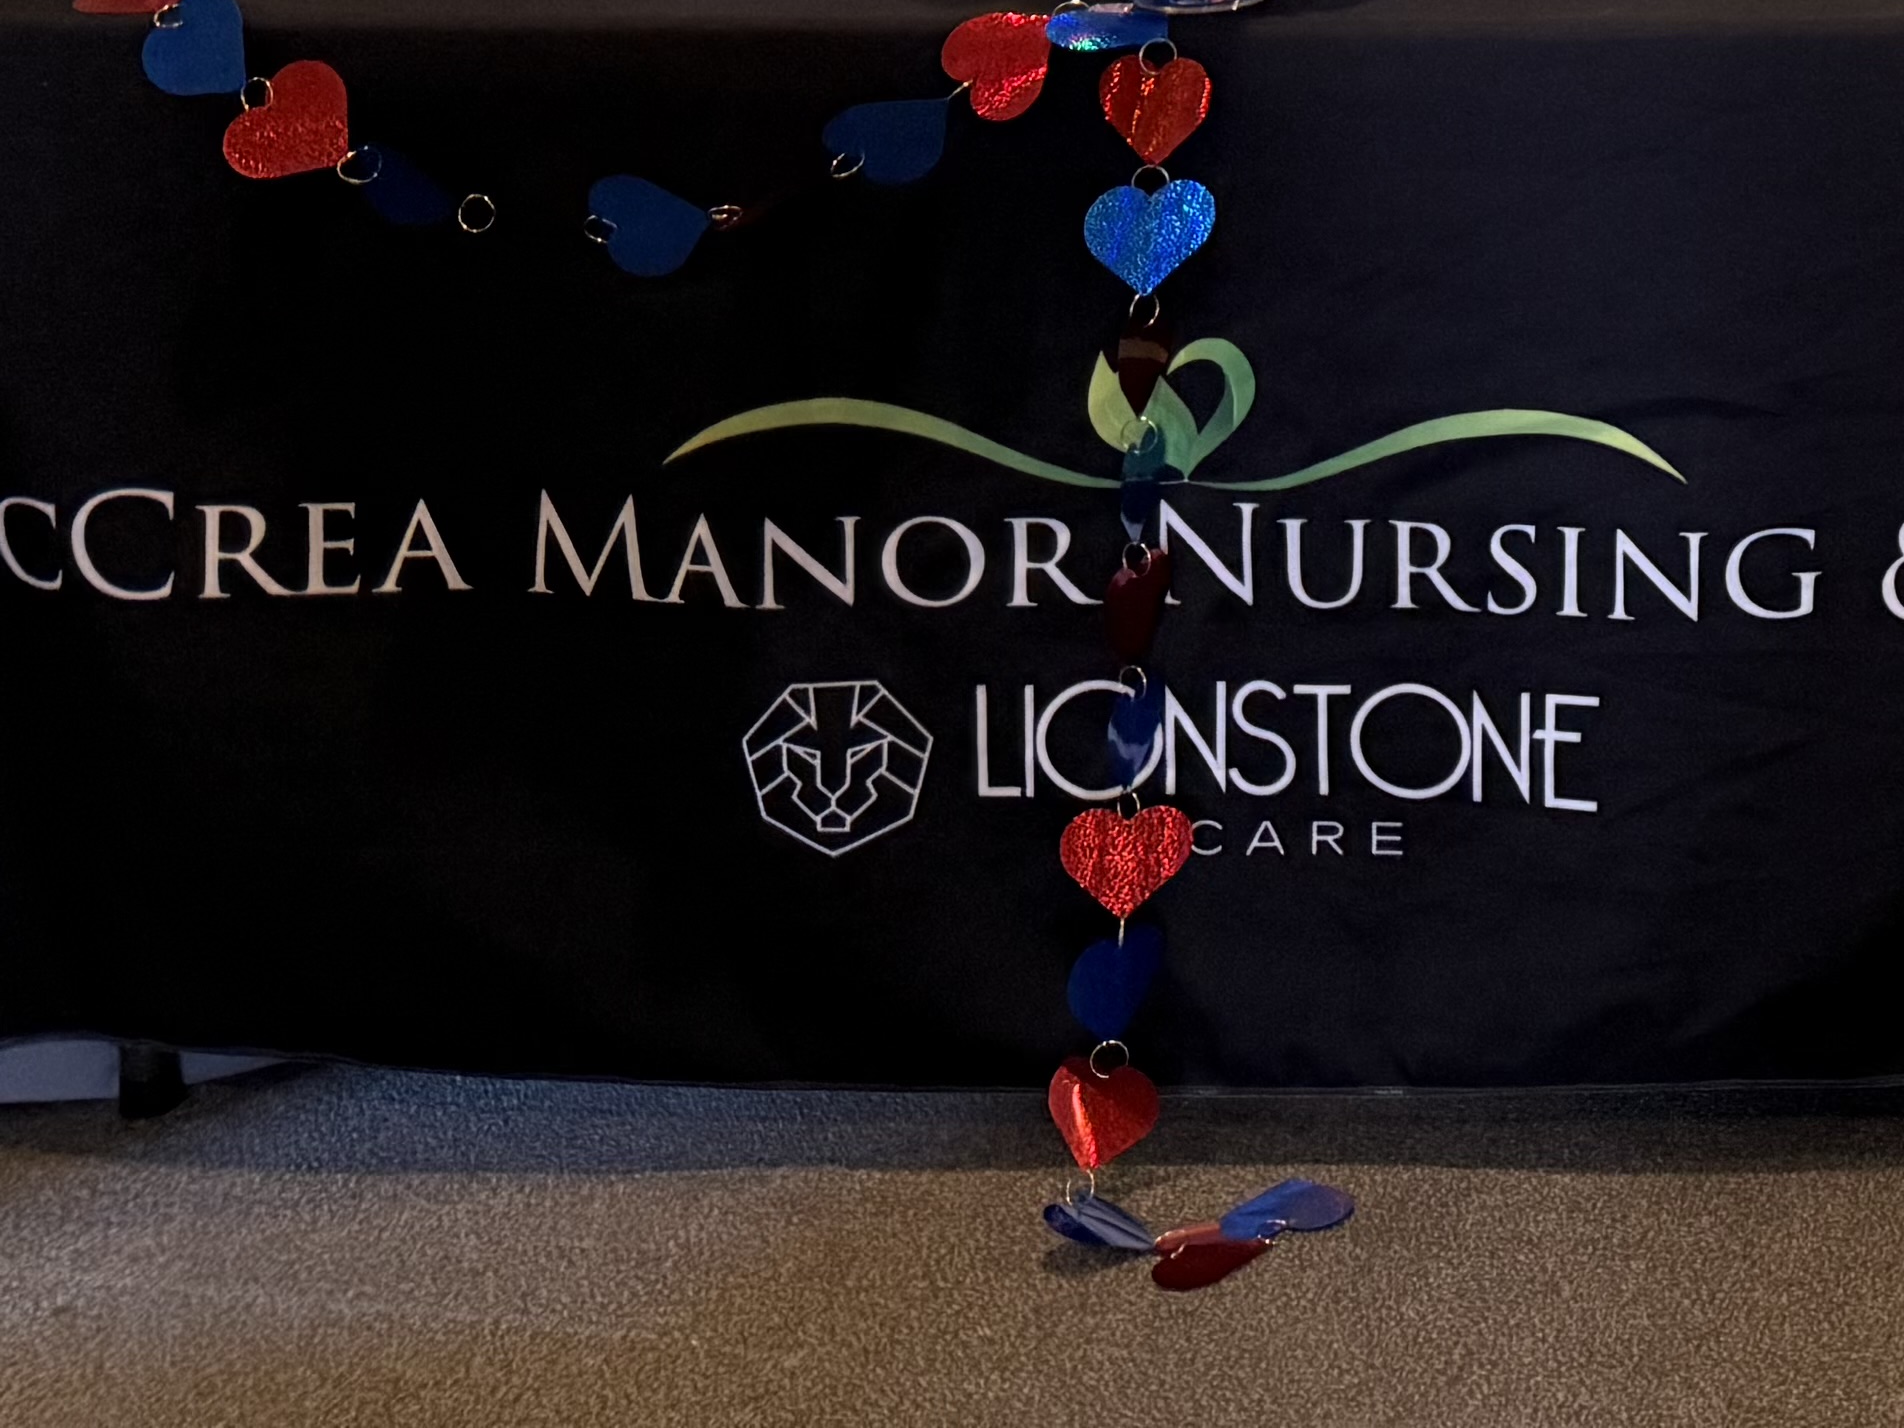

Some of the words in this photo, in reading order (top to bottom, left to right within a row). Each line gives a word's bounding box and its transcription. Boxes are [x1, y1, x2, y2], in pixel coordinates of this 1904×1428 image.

[527, 488, 1104, 610] MANOR
[1158, 498, 1822, 623] NURSING
[975, 679, 1600, 812] LIONSTONE
[1191, 819, 1403, 856] CARE
